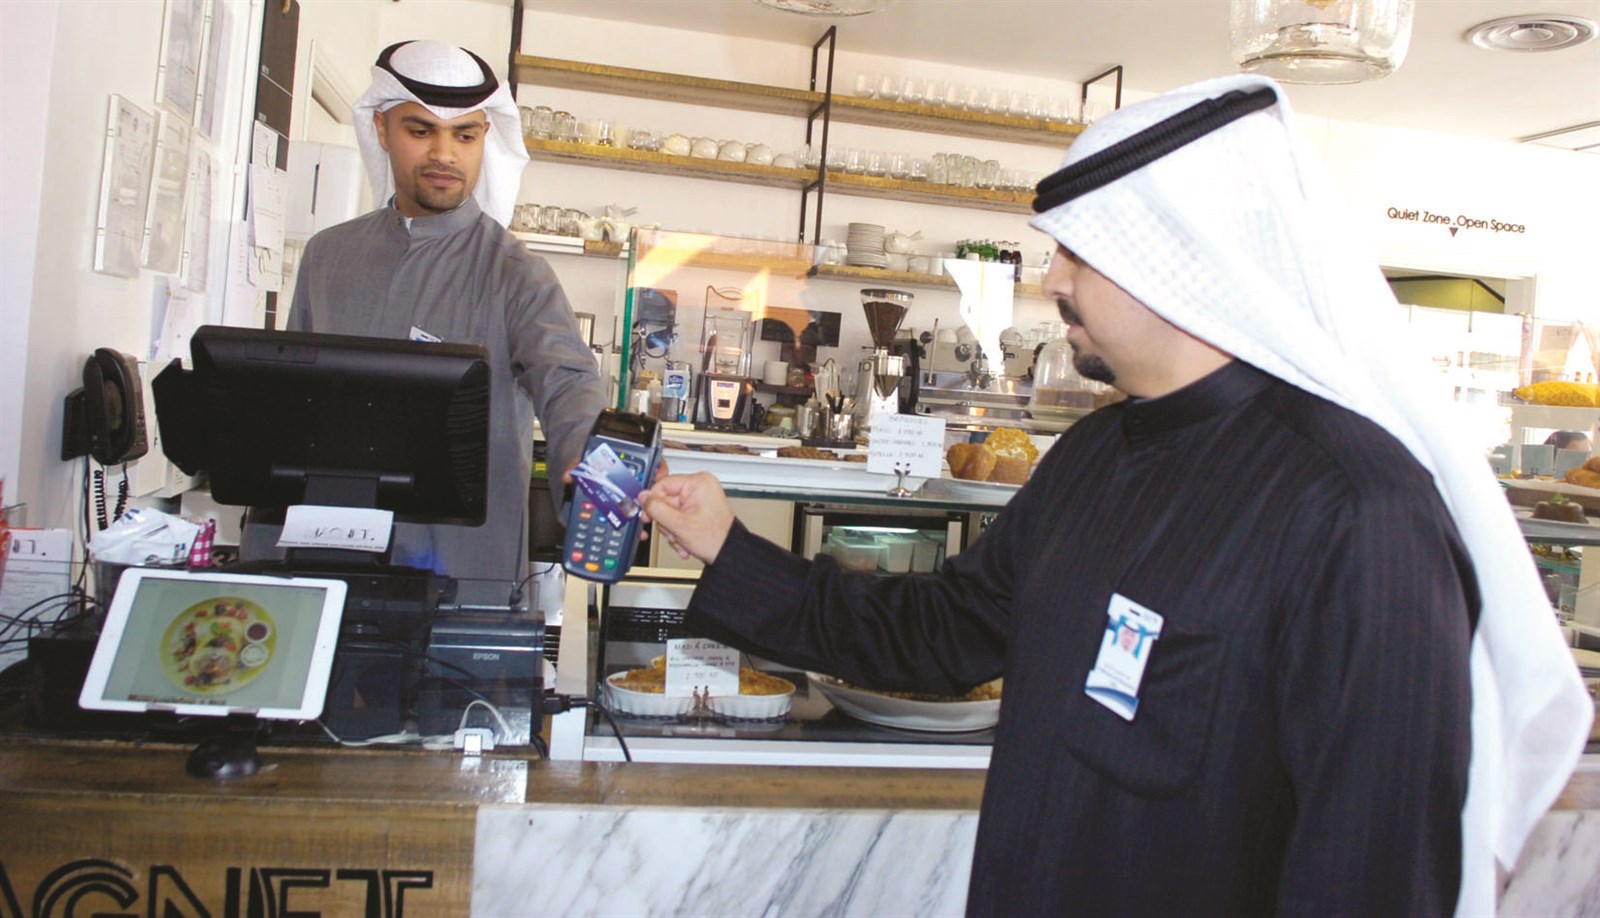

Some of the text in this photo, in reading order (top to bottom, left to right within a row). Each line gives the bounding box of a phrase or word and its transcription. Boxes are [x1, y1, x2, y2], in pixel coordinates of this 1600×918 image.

[1387, 207, 1419, 221] Quiet
[1423, 211, 1451, 225] Zone
[1490, 219, 1526, 234] Space
[473, 652, 500, 661] EPSON
